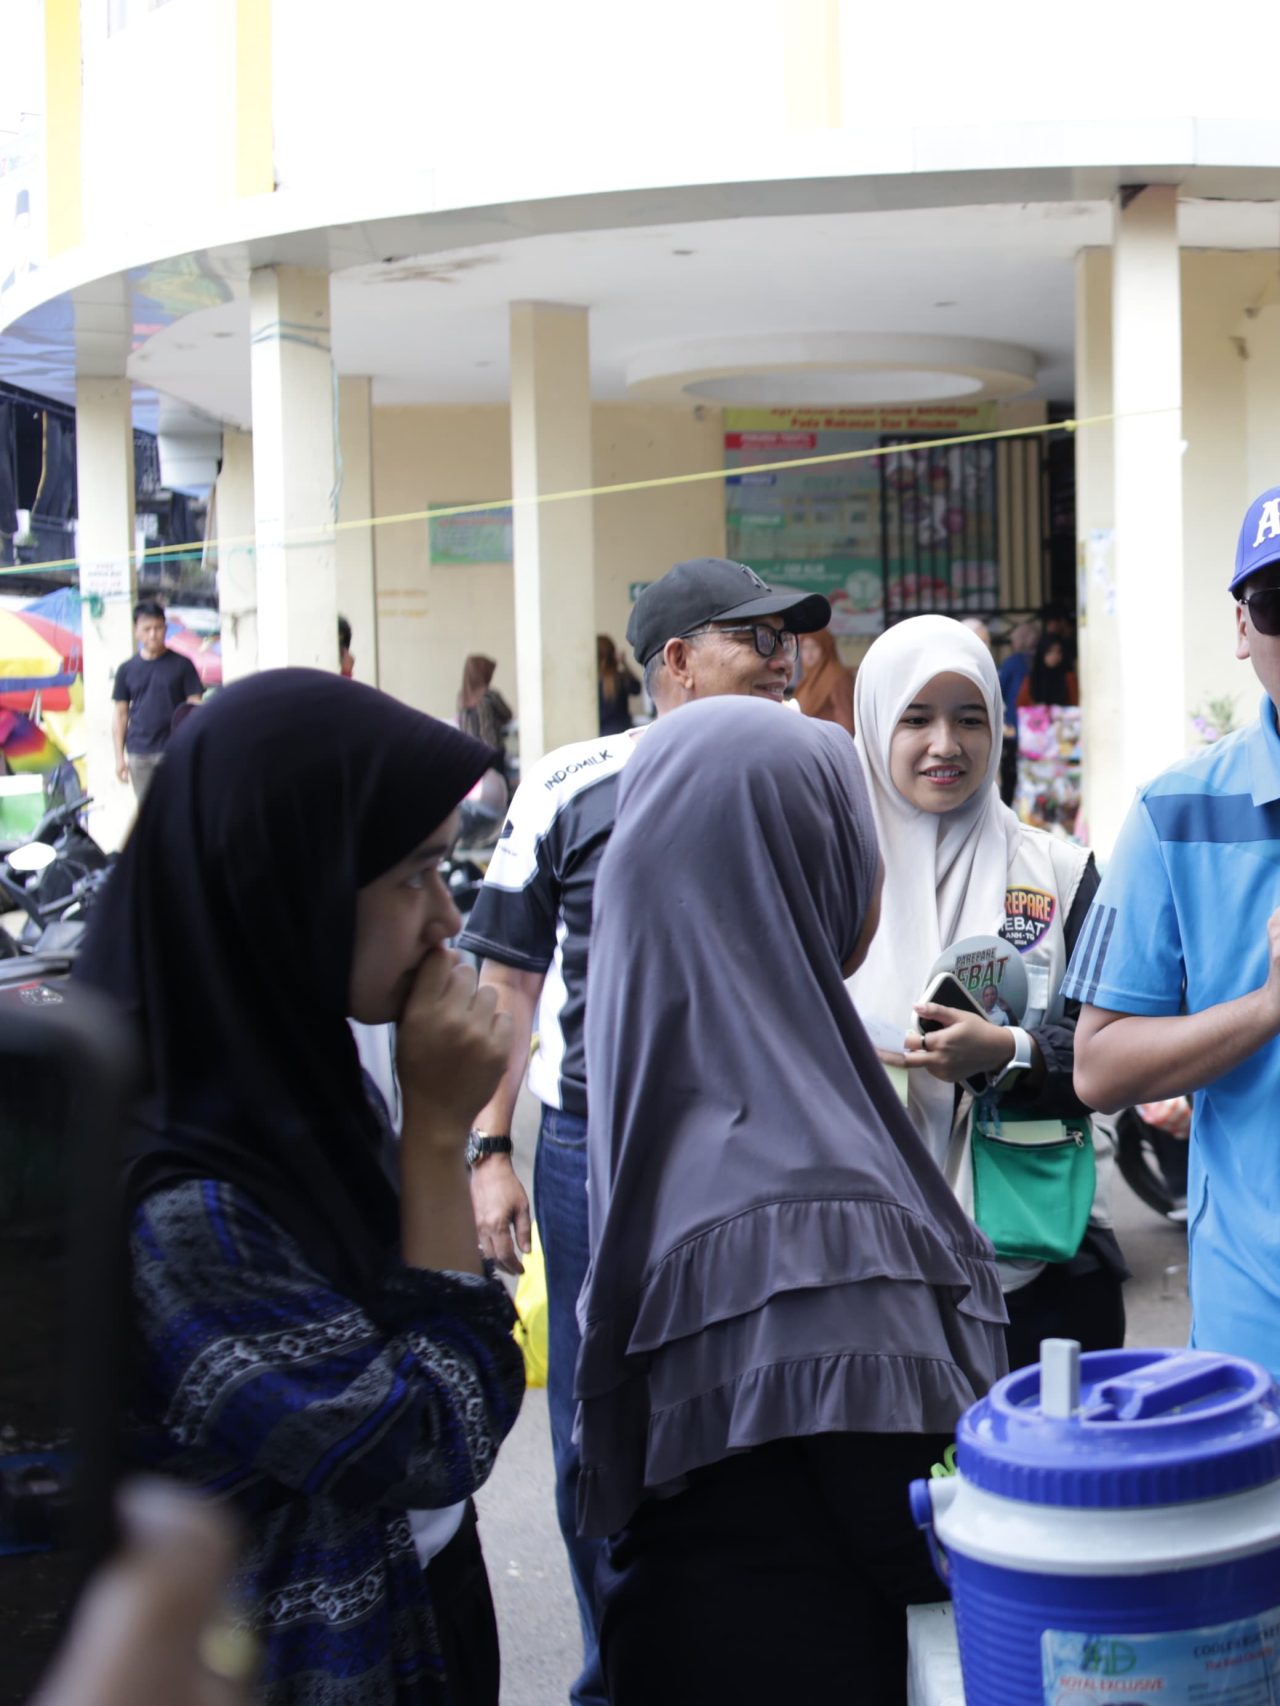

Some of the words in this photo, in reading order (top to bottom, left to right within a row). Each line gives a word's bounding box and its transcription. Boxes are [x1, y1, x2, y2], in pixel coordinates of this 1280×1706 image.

[543, 749, 614, 792] INDOMILK
[1002, 916, 1046, 937] EBAT
[955, 947, 998, 968] PAREPARE
[951, 955, 1010, 991] EBAT
